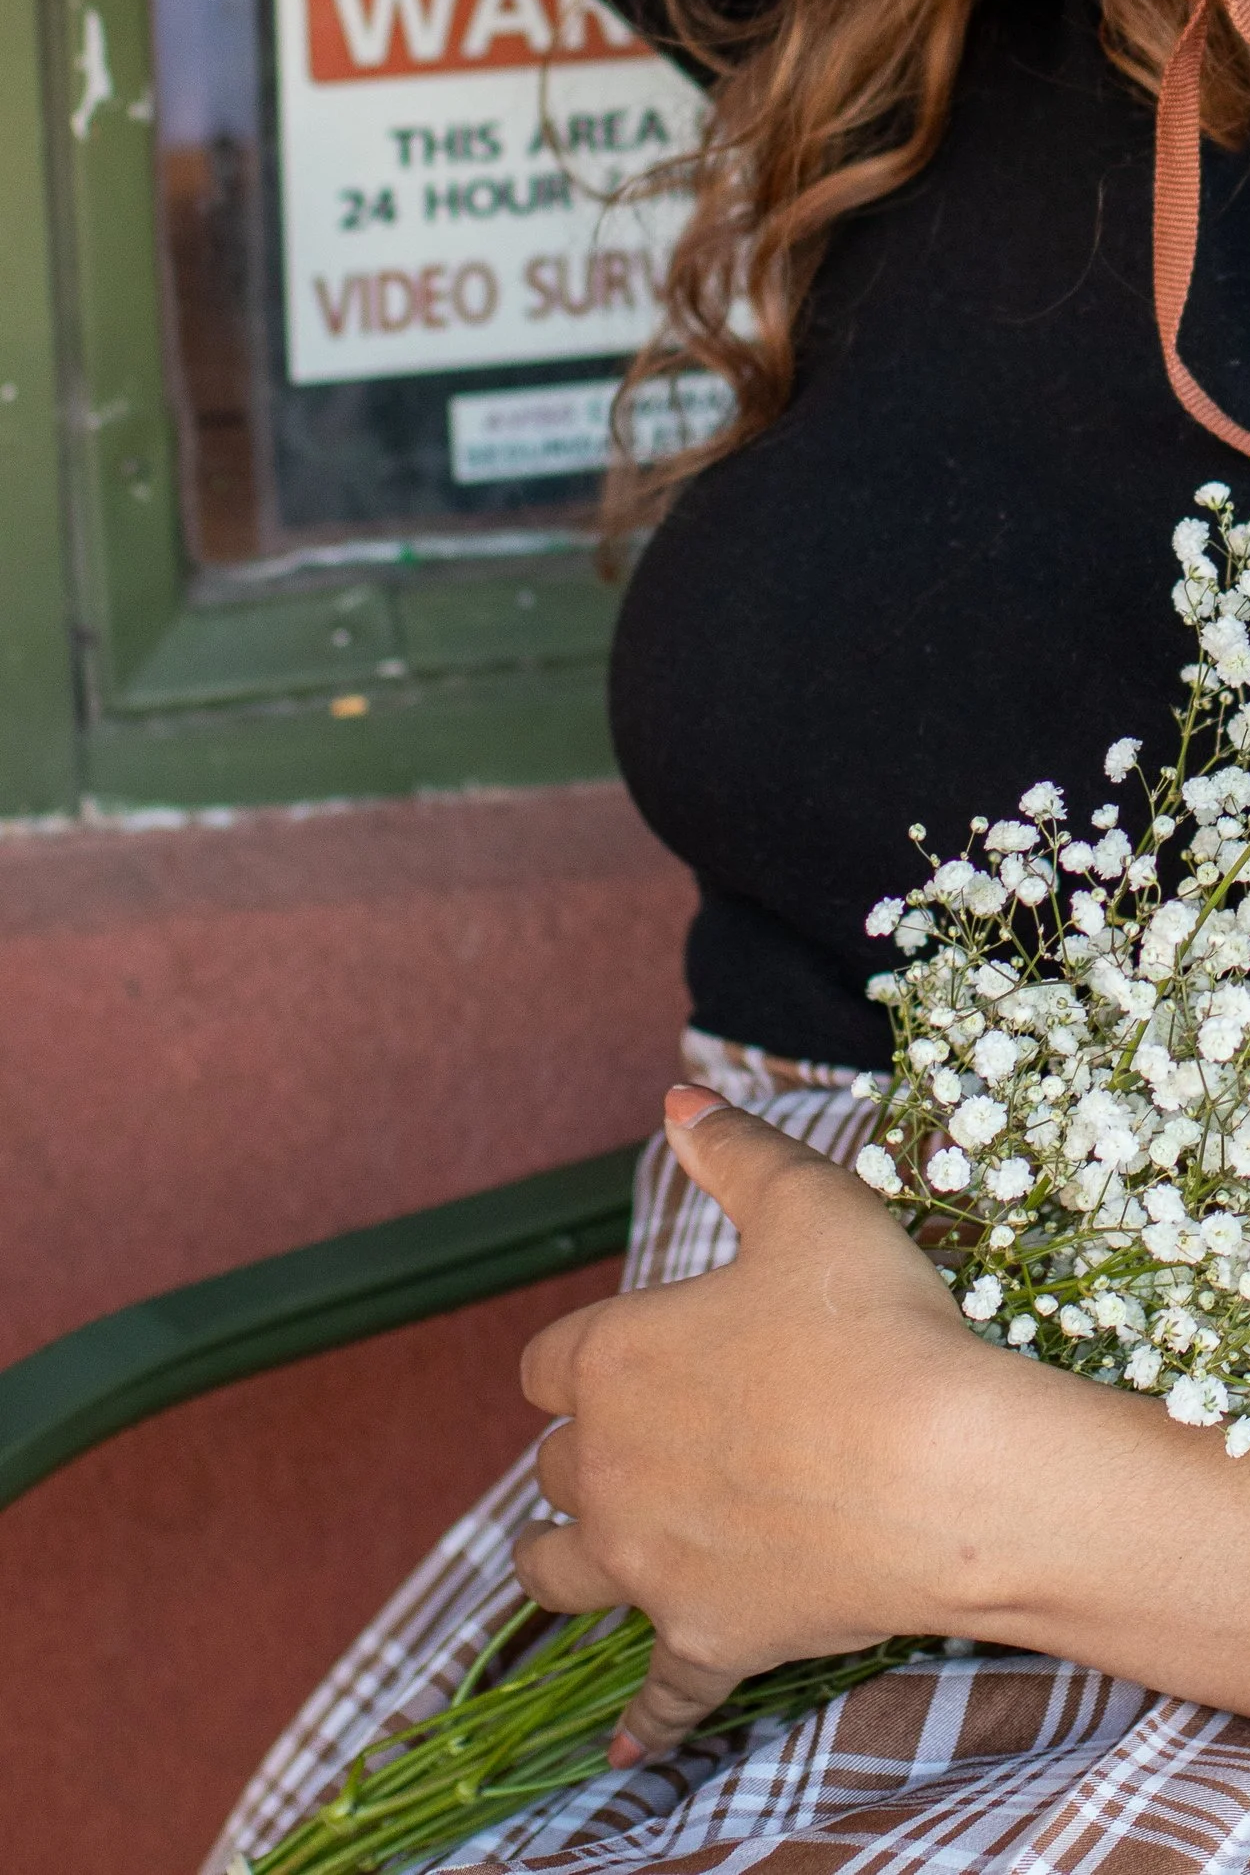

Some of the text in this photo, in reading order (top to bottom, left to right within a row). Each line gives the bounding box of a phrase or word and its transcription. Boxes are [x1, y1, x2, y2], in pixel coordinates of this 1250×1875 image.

[390, 119, 503, 169] THIS
[528, 107, 670, 156] AREA
[340, 186, 397, 231] 24
[423, 171, 575, 222] HOUR
[313, 261, 500, 339] VIDEO
